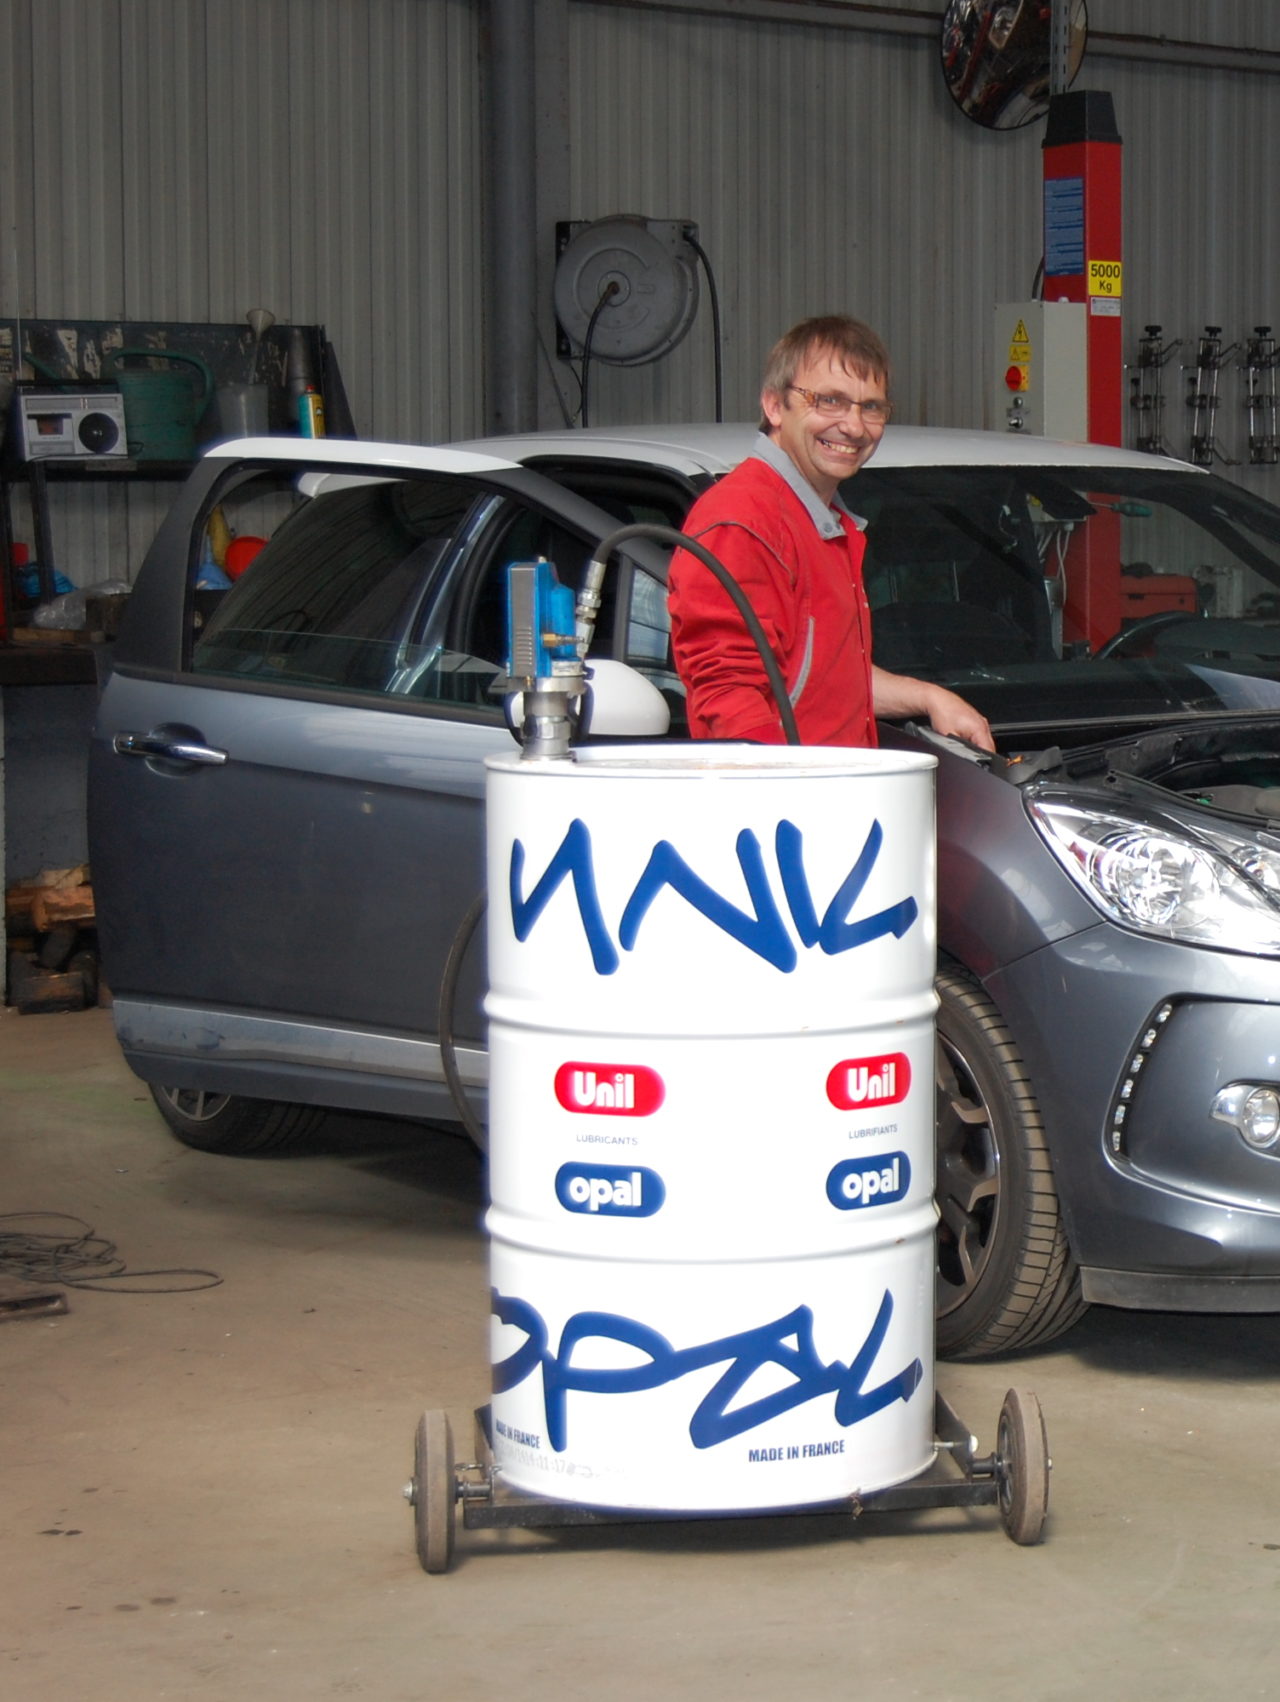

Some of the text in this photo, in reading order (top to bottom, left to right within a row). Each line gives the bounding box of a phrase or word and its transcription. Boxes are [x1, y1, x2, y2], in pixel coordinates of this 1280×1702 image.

[1091, 264, 1120, 278] 5000
[1099, 281, 1112, 293] Kg
[573, 1071, 635, 1109] Unil
[847, 1062, 896, 1102] Unil
[576, 1134, 639, 1147] LUBRICANTS
[848, 1123, 898, 1140] LUBRIFIANTS
[569, 1172, 642, 1211] opal
[841, 1157, 899, 1205] opal
[513, 1428, 540, 1448] FRANCE
[748, 1439, 845, 1463] MADE IN FRANCE
